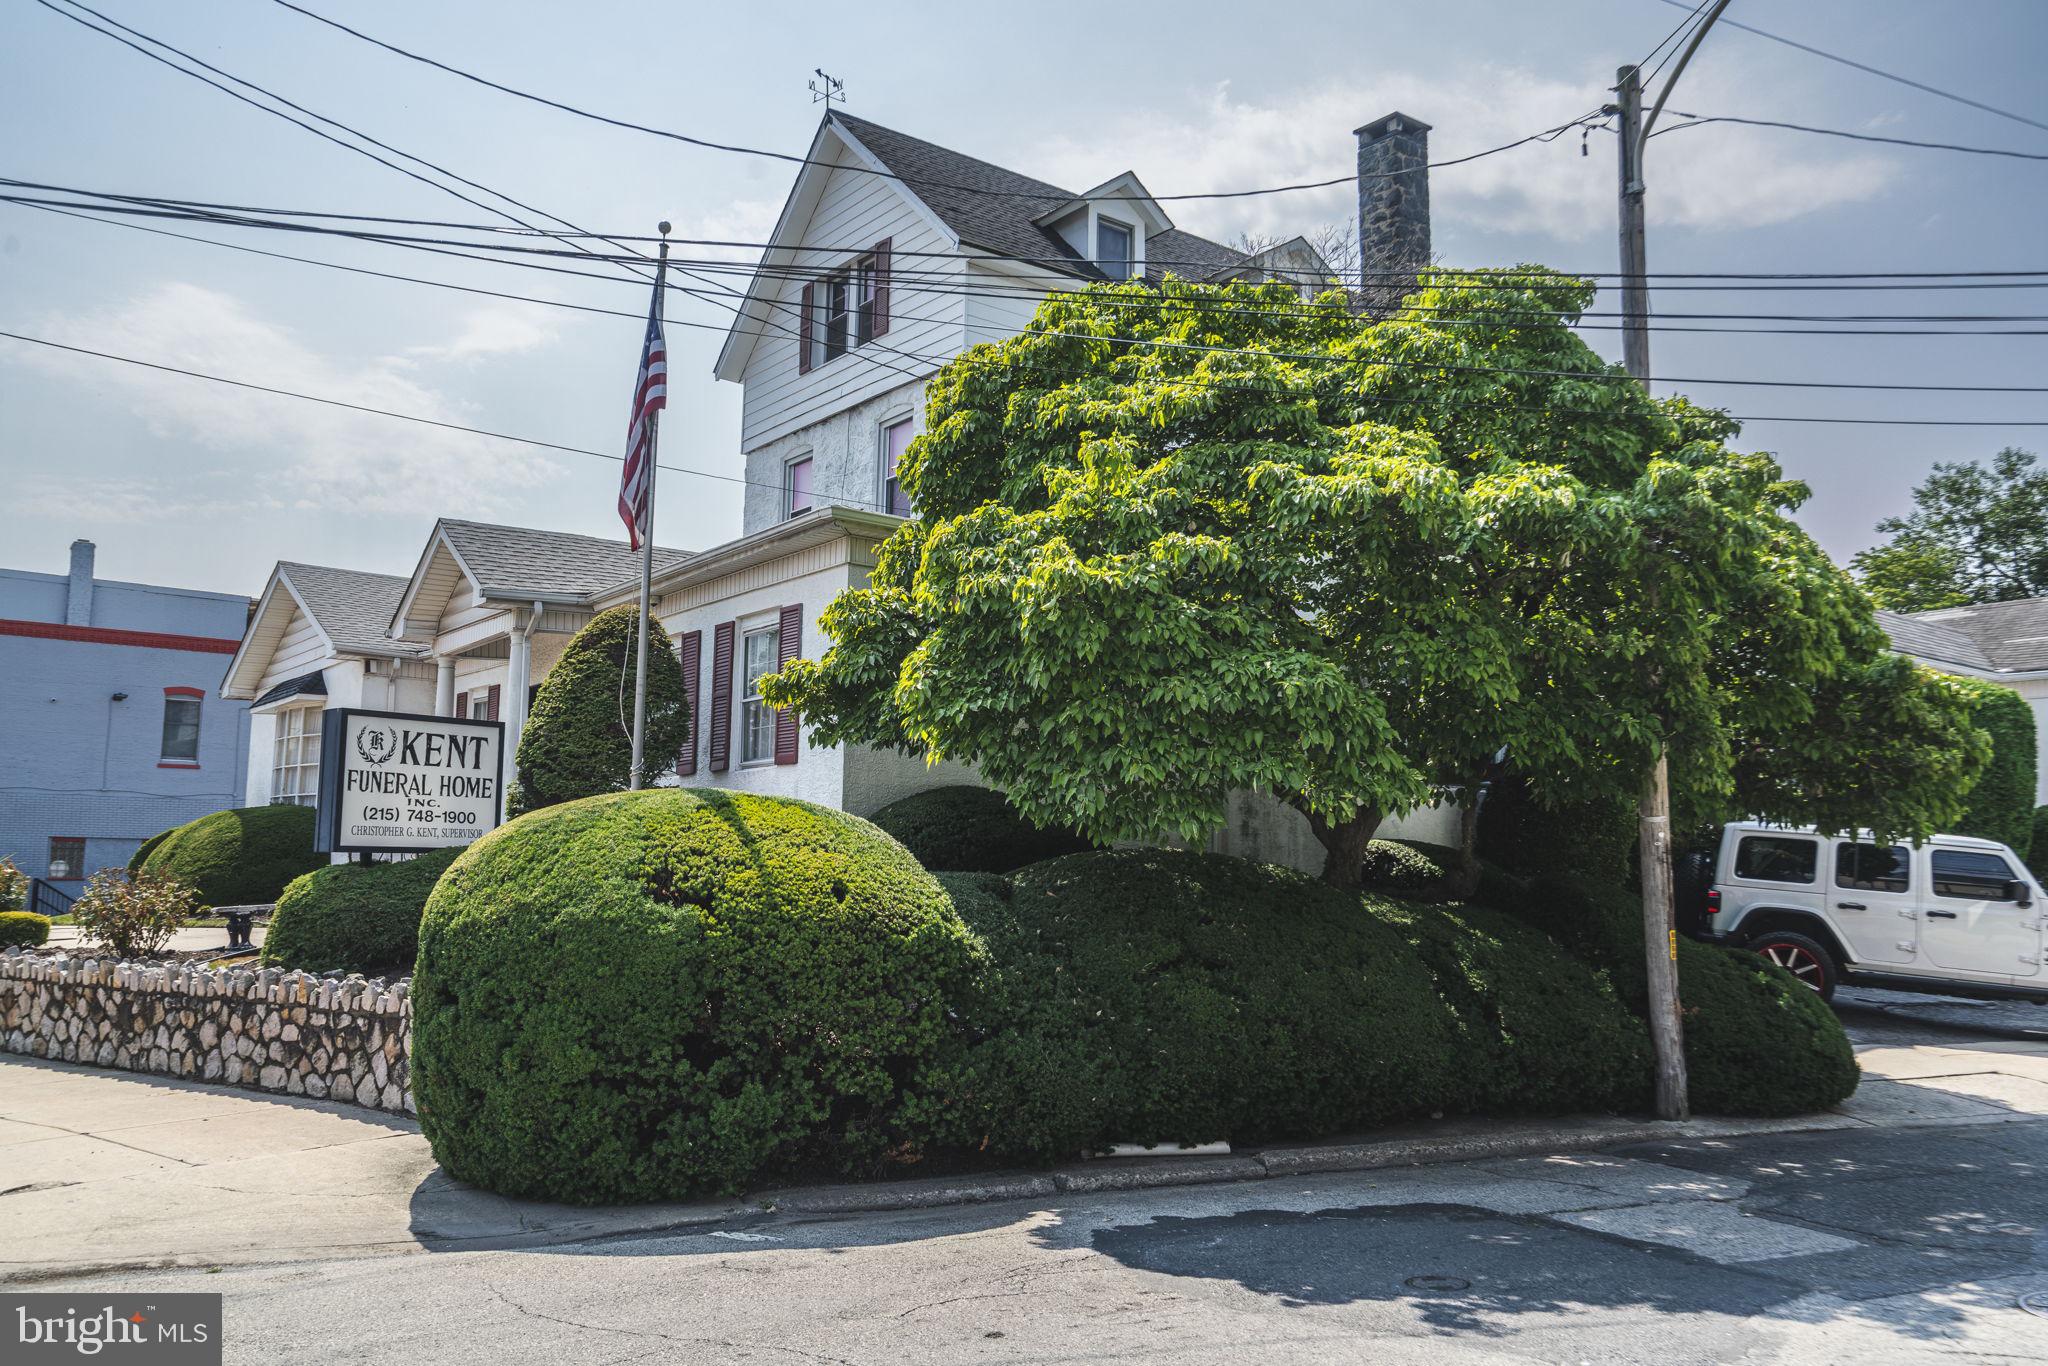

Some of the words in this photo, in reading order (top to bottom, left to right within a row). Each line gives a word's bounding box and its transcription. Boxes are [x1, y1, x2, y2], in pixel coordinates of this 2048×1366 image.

[400, 730, 489, 769] KENT
[347, 769, 433, 797] FUNERAL
[440, 775, 493, 799] HOME
[407, 798, 441, 808] INC.
[363, 805, 400, 822] (215)
[407, 809, 476, 824] 748-1900
[351, 825, 404, 837] CHRISTOPHER
[406, 826, 415, 837] G.
[416, 827, 440, 840] KENT,
[441, 827, 483, 839] SUPERVISOR
